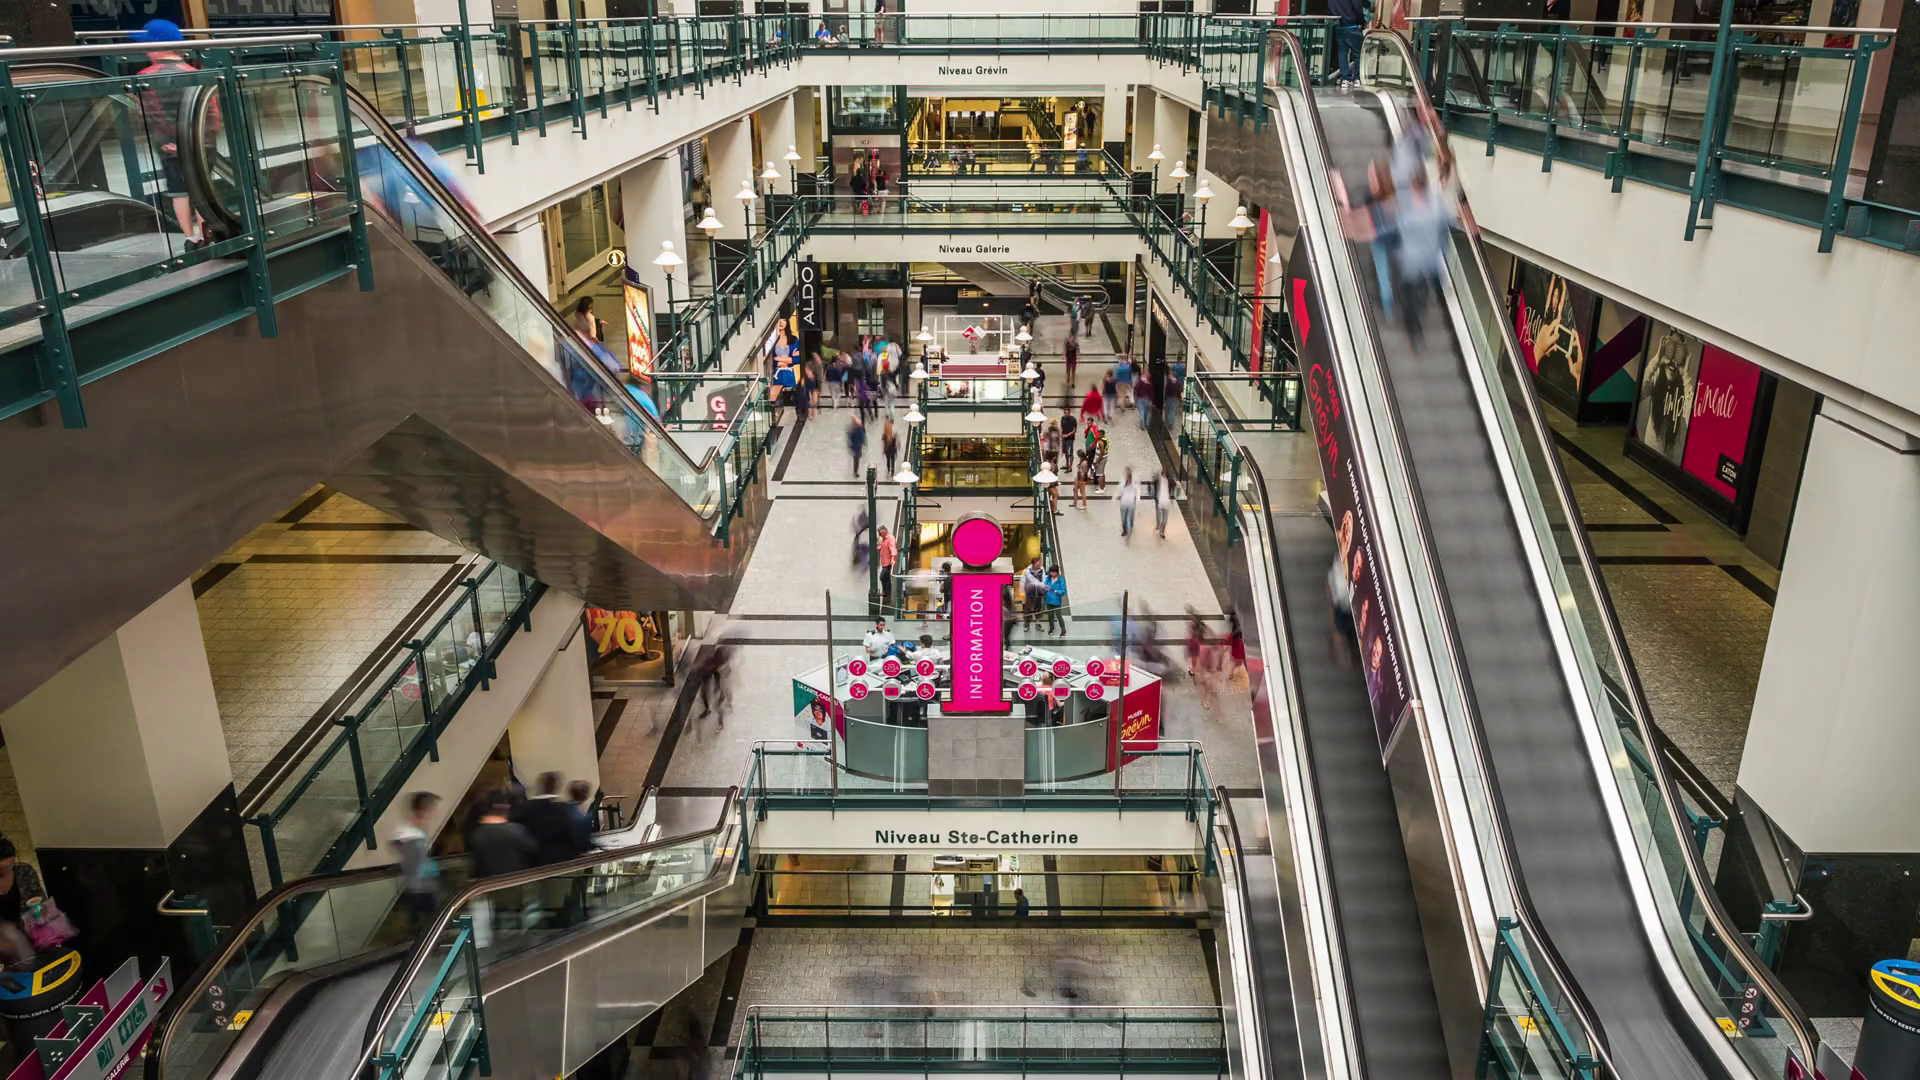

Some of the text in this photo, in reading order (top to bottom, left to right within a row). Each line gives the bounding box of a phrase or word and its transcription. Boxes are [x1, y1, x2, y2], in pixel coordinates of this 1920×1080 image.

[938, 65, 1008, 75] Niveau Grévin
[938, 244, 1010, 253] Niveau Galerie
[801, 266, 815, 325] ALDO
[1346, 458, 1353, 472] LE
[1356, 503, 1363, 518] LE
[1360, 516, 1369, 544] PLUS
[1365, 542, 1387, 617] DIVERTISSANT
[1382, 616, 1390, 634] DE
[970, 589, 984, 699] INFORMATION
[875, 830, 1079, 844] Niveau Ste-Catherine
[1883, 1013, 1898, 1024] PETIT
[1898, 1021, 1916, 1032] GESTE
